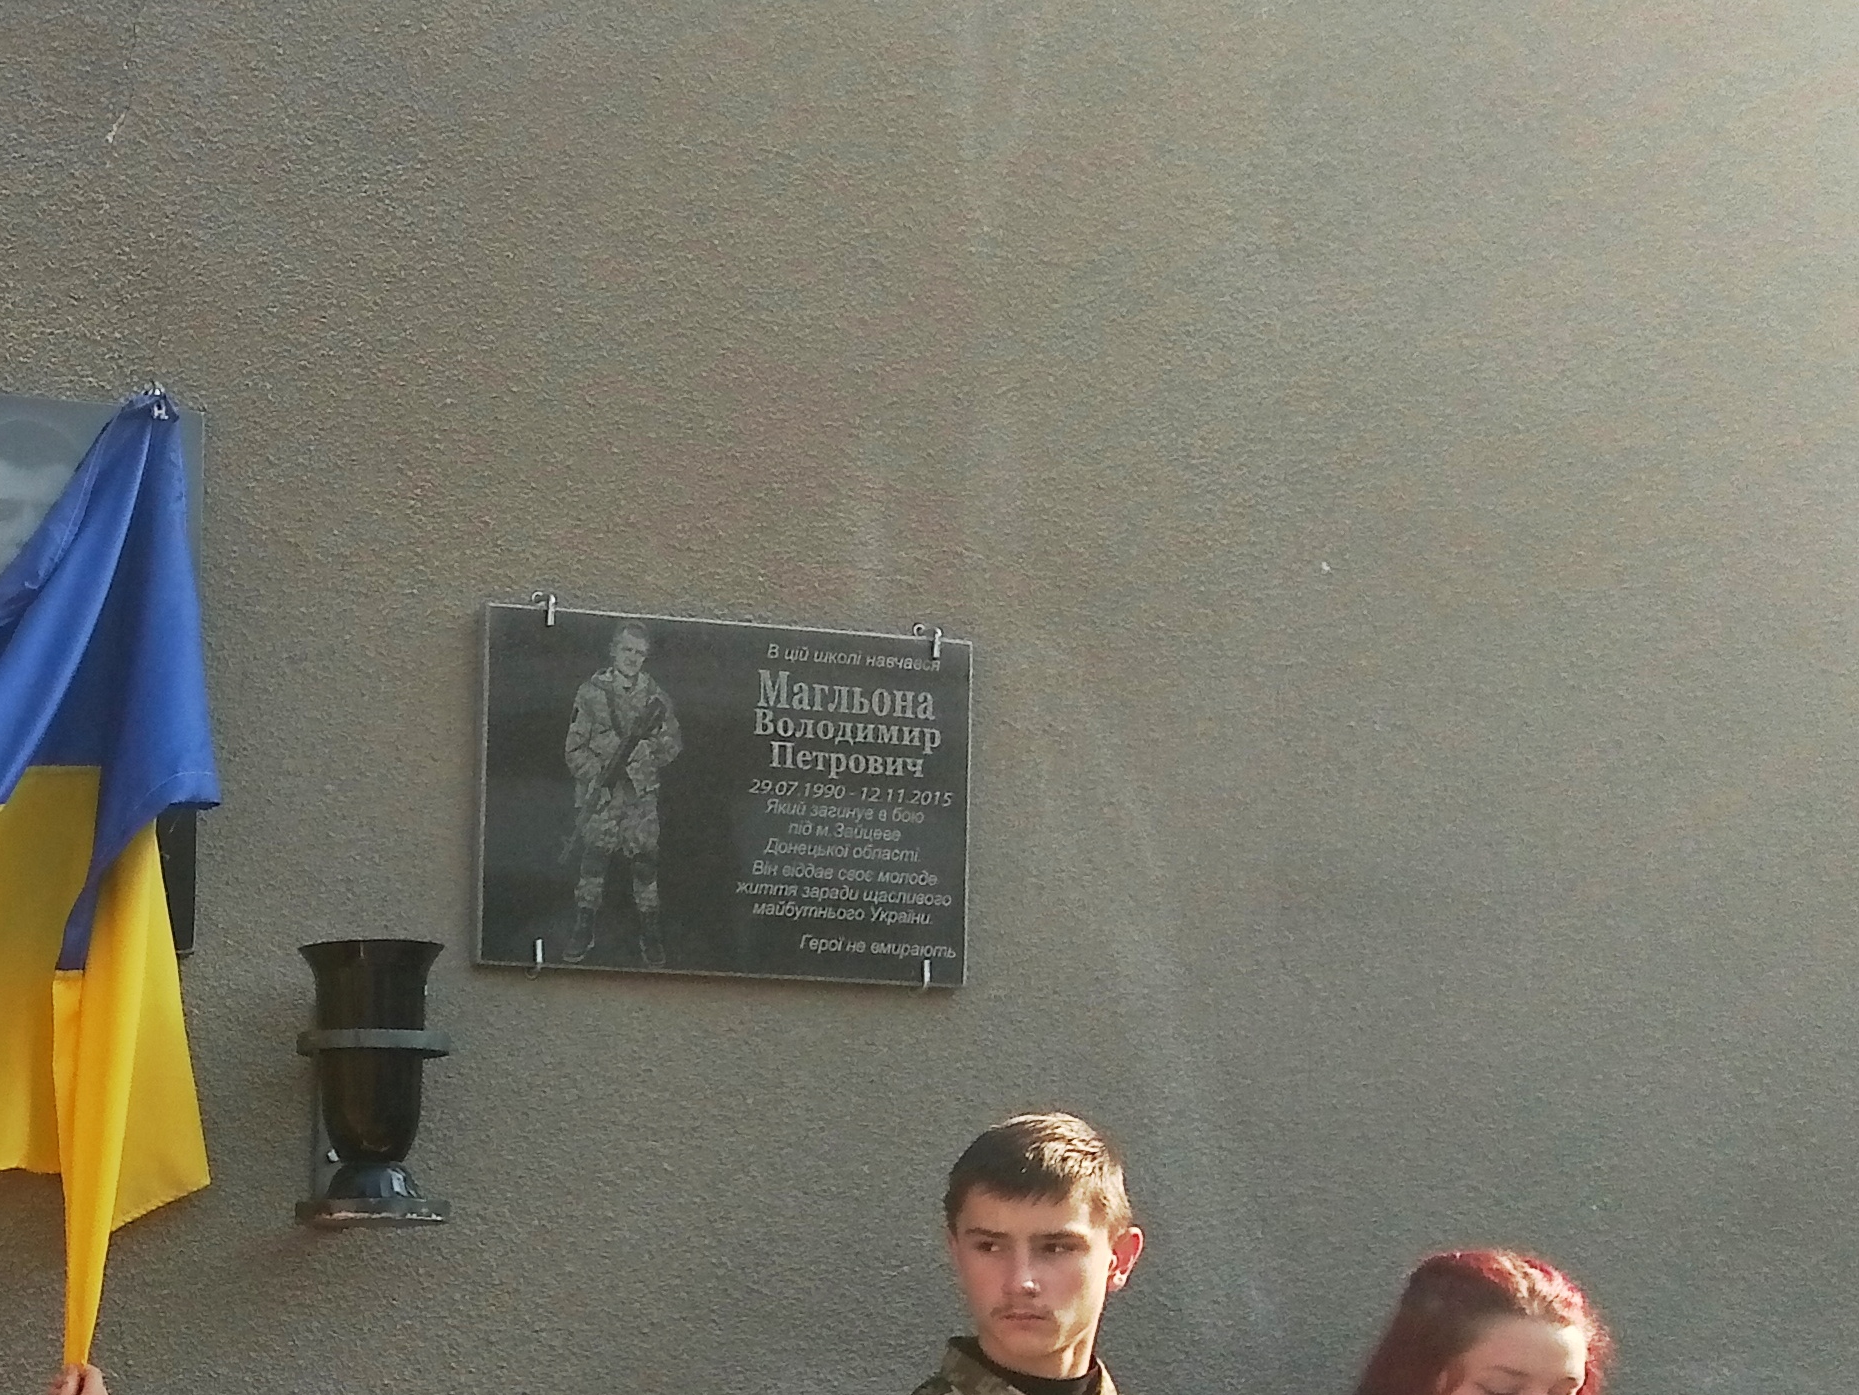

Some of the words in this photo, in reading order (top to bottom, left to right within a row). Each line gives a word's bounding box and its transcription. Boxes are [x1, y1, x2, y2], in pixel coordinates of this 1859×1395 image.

[767, 643, 780, 659] В
[784, 646, 810, 664] цій
[813, 649, 862, 666] школі
[865, 653, 941, 672] навчався
[757, 669, 936, 720] Магльона
[753, 708, 941, 754] Володимир
[769, 741, 924, 779] Петрович
[748, 779, 846, 800] 29.07.1990
[860, 786, 954, 807] 12.11.2015
[765, 798, 807, 815] Який
[810, 804, 874, 823] загинув
[878, 808, 888, 822] в
[892, 802, 925, 824] бою
[788, 820, 813, 836] під
[763, 837, 851, 859] Донецької
[752, 859, 779, 877] Він
[782, 861, 834, 880] віддав
[838, 868, 875, 883] своє
[877, 869, 939, 887] молоде
[736, 881, 799, 896] життя
[801, 884, 859, 903] заради
[863, 888, 952, 907] щасливого
[752, 900, 866, 921] майбутнього
[799, 934, 845, 954] Герої
[846, 940, 867, 954] не
[870, 940, 957, 960] вмирають
